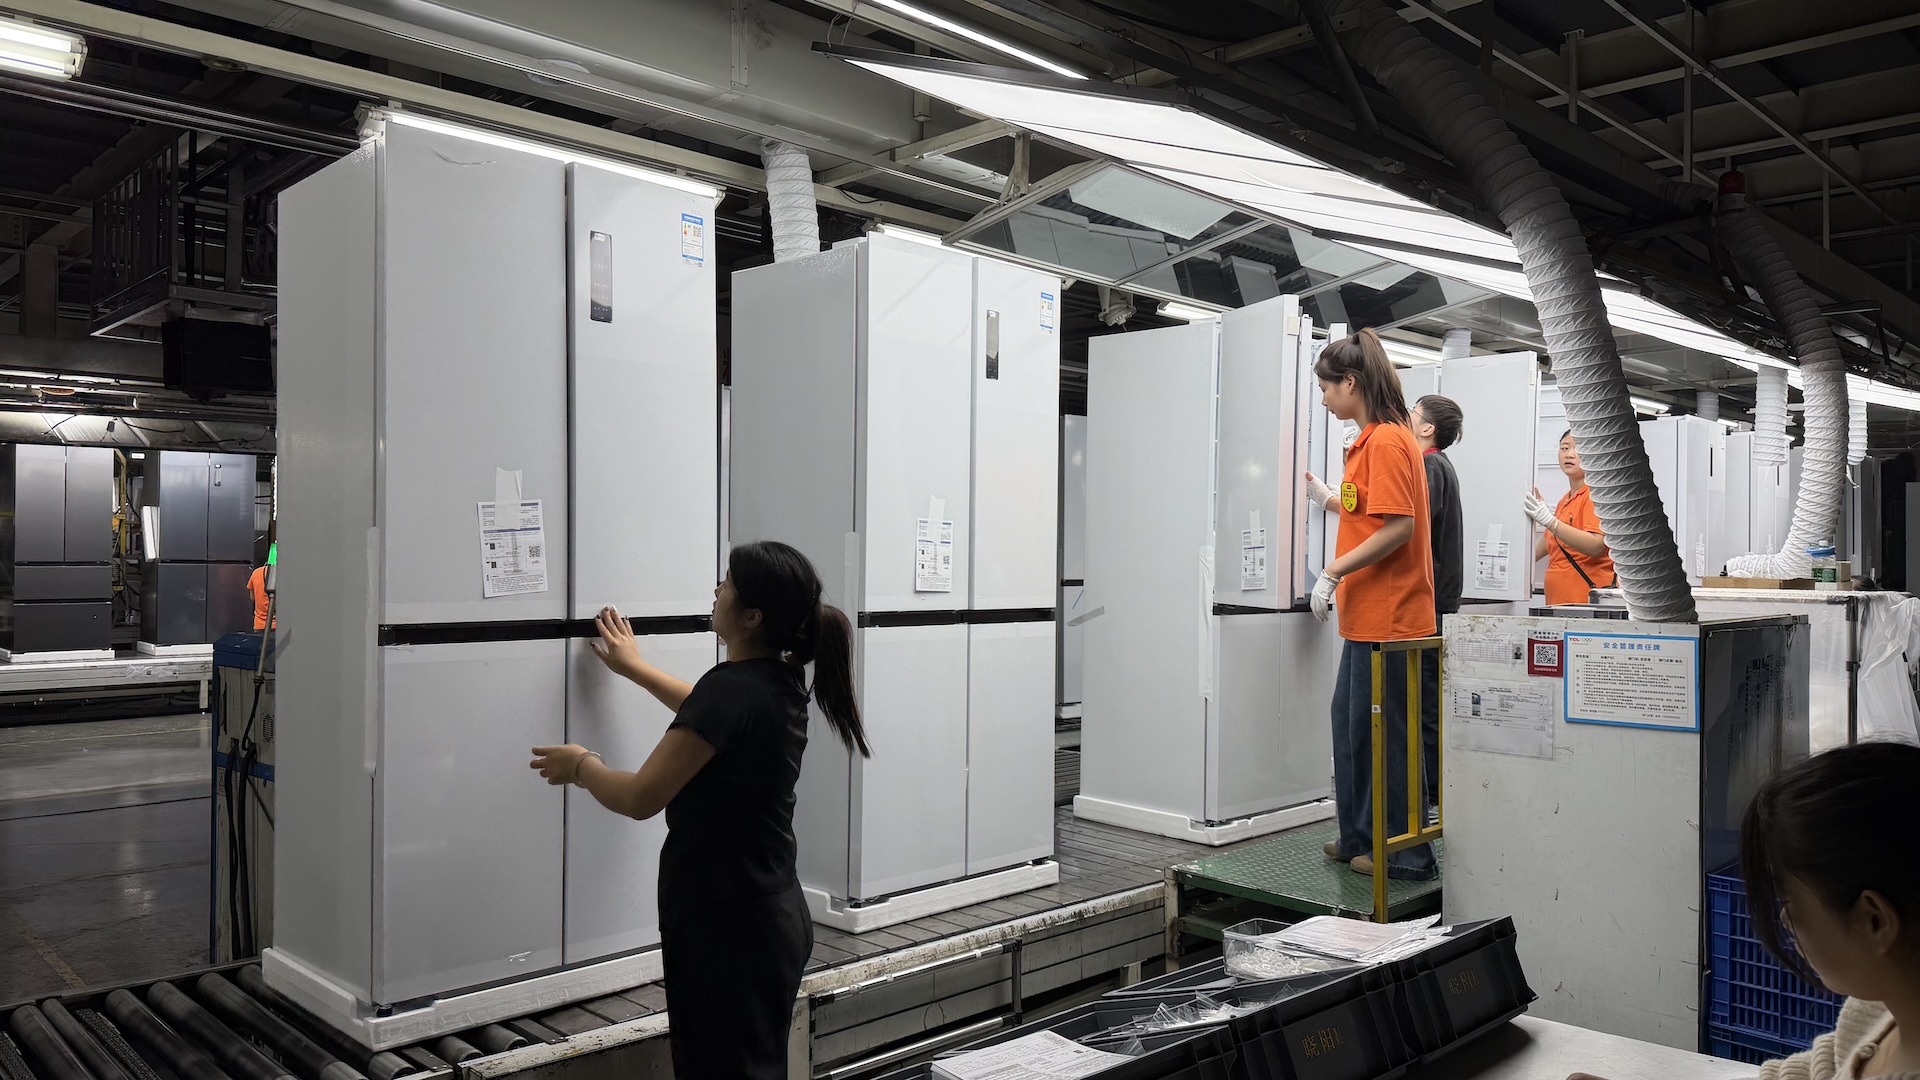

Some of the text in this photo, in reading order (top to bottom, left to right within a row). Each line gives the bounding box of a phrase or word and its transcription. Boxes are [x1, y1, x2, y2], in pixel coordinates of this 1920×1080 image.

[1603, 641, 1660, 651] 安全管理责任牌
